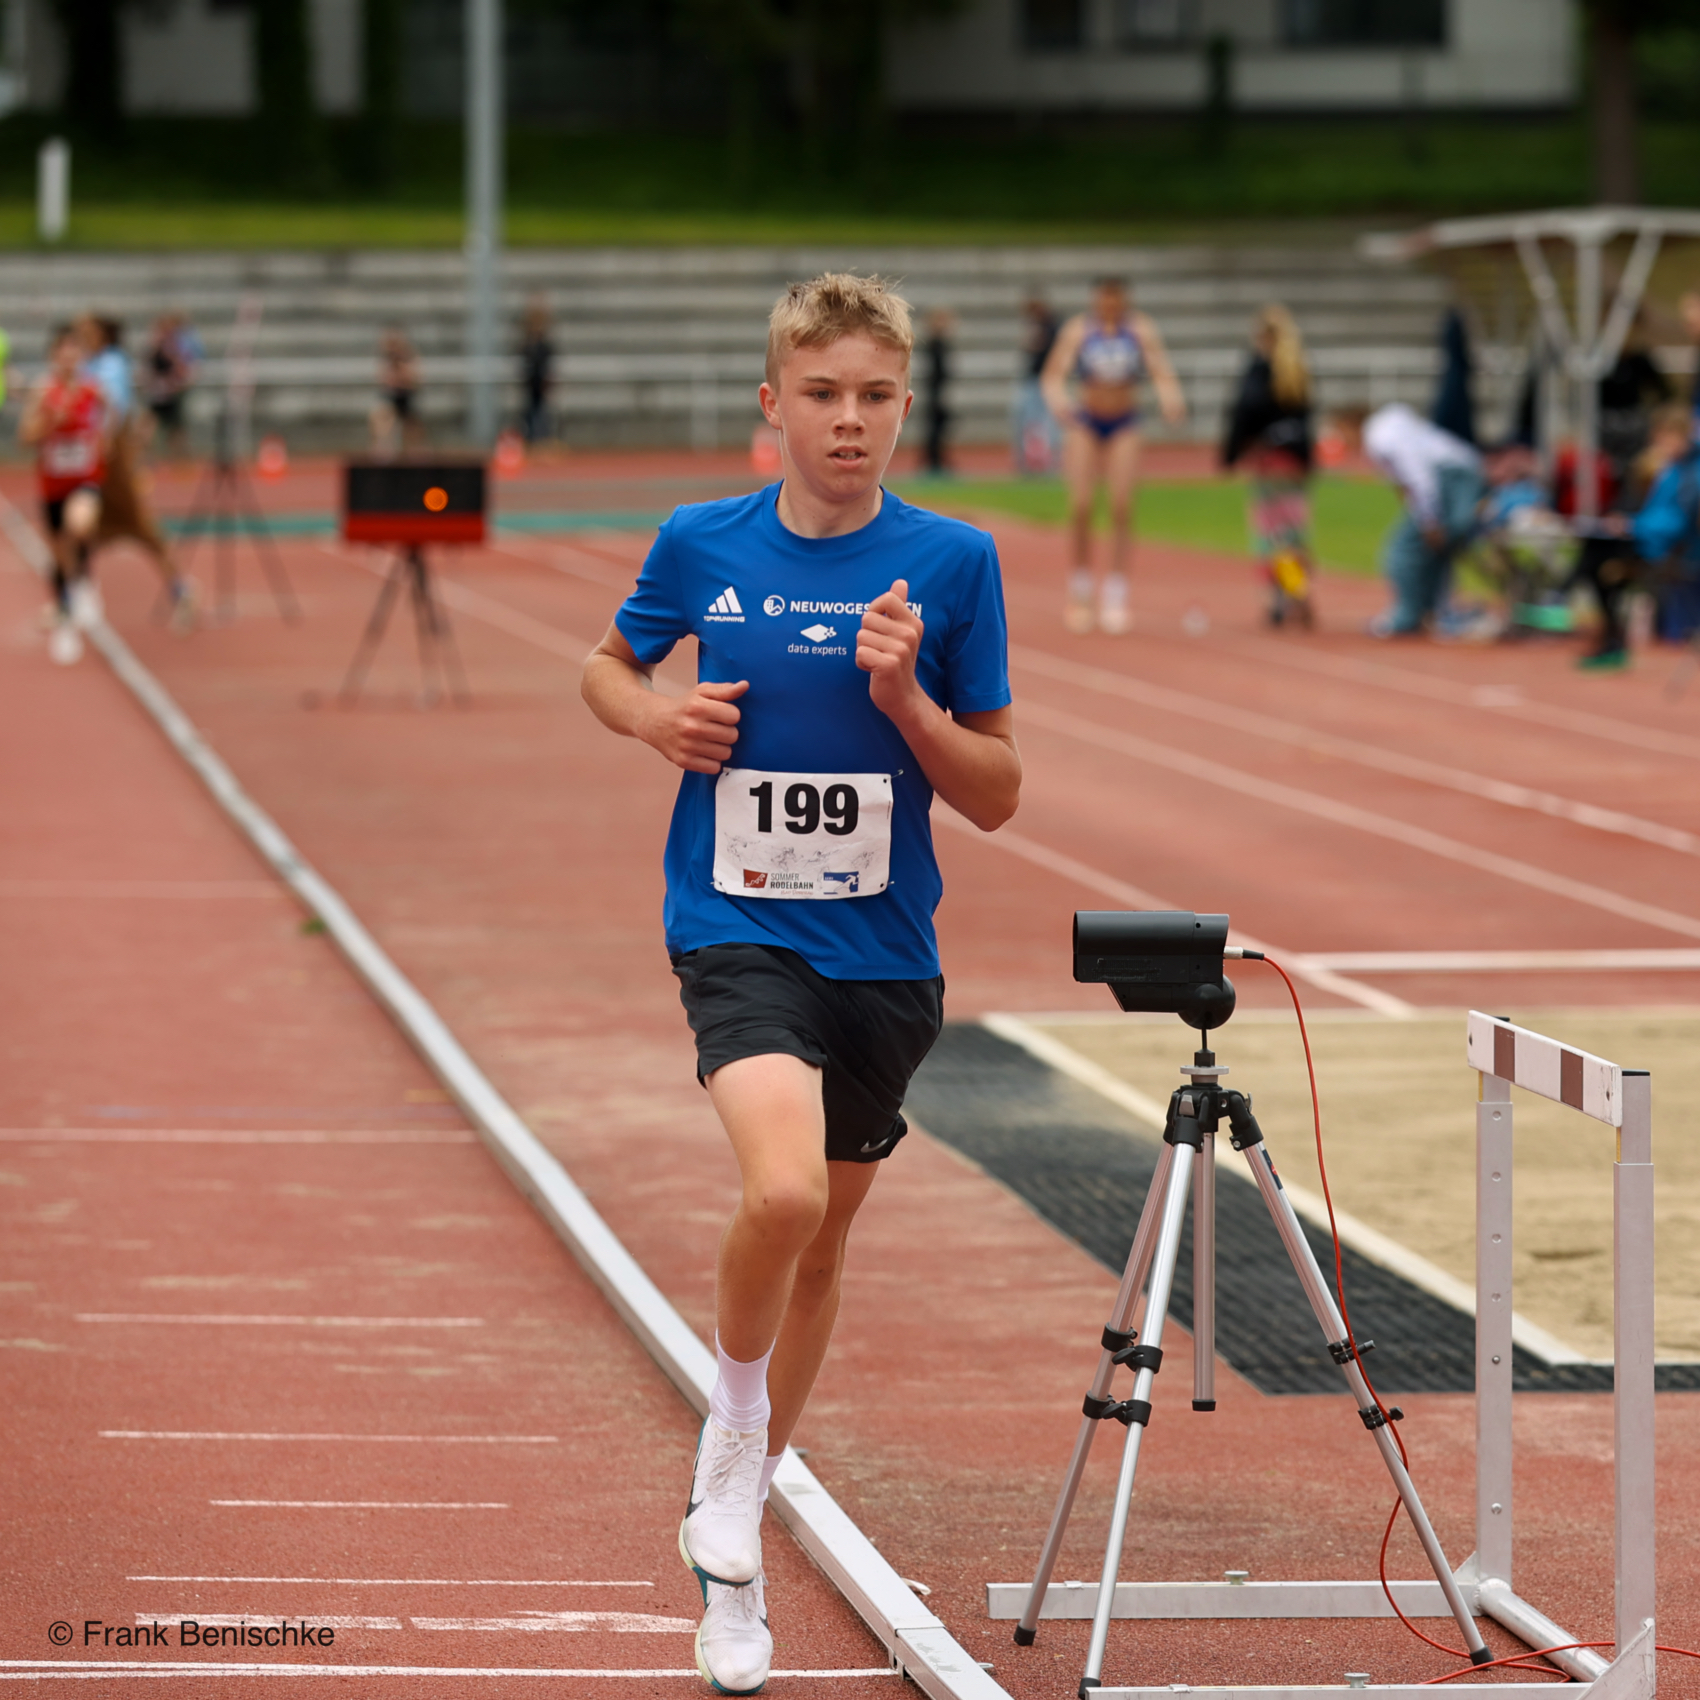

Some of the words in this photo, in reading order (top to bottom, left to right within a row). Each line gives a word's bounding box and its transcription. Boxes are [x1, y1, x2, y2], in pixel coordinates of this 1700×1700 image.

[787, 643, 810, 654] data
[811, 645, 847, 657] experts
[749, 781, 860, 836] 199
[770, 872, 800, 881] SOMMER
[770, 881, 814, 890] RODELBAHN
